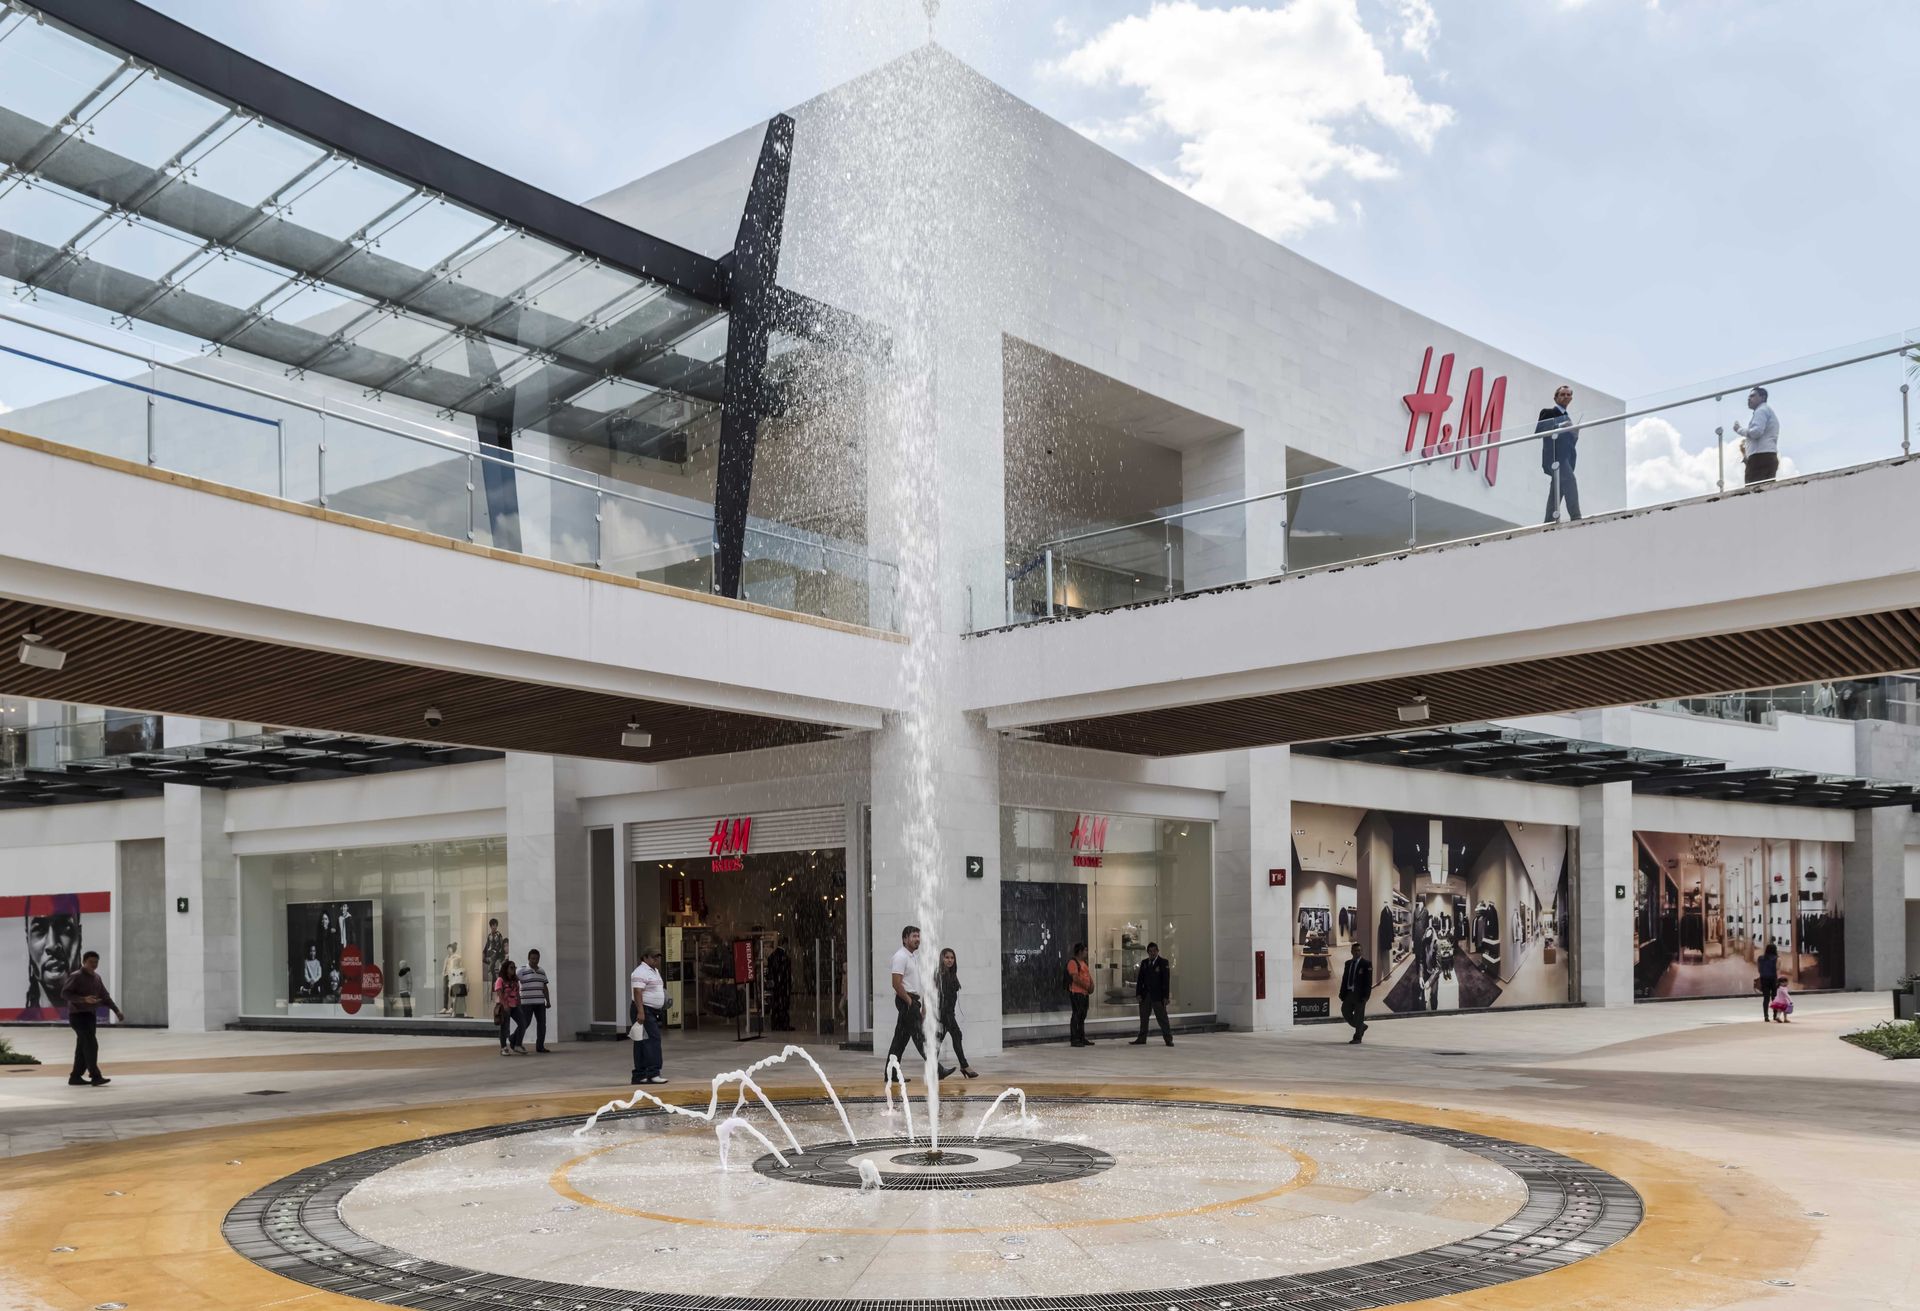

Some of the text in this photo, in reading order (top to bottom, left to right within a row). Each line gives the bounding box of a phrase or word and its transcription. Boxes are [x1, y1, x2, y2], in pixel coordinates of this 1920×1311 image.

[1403, 346, 1507, 487] H&M
[709, 816, 752, 855] H&M
[1069, 815, 1108, 852] H&M
[1073, 855, 1103, 868] HOME
[745, 942, 754, 980] REBAJAS
[1014, 954, 1026, 963] $79
[1301, 1004, 1320, 1012] mundo
